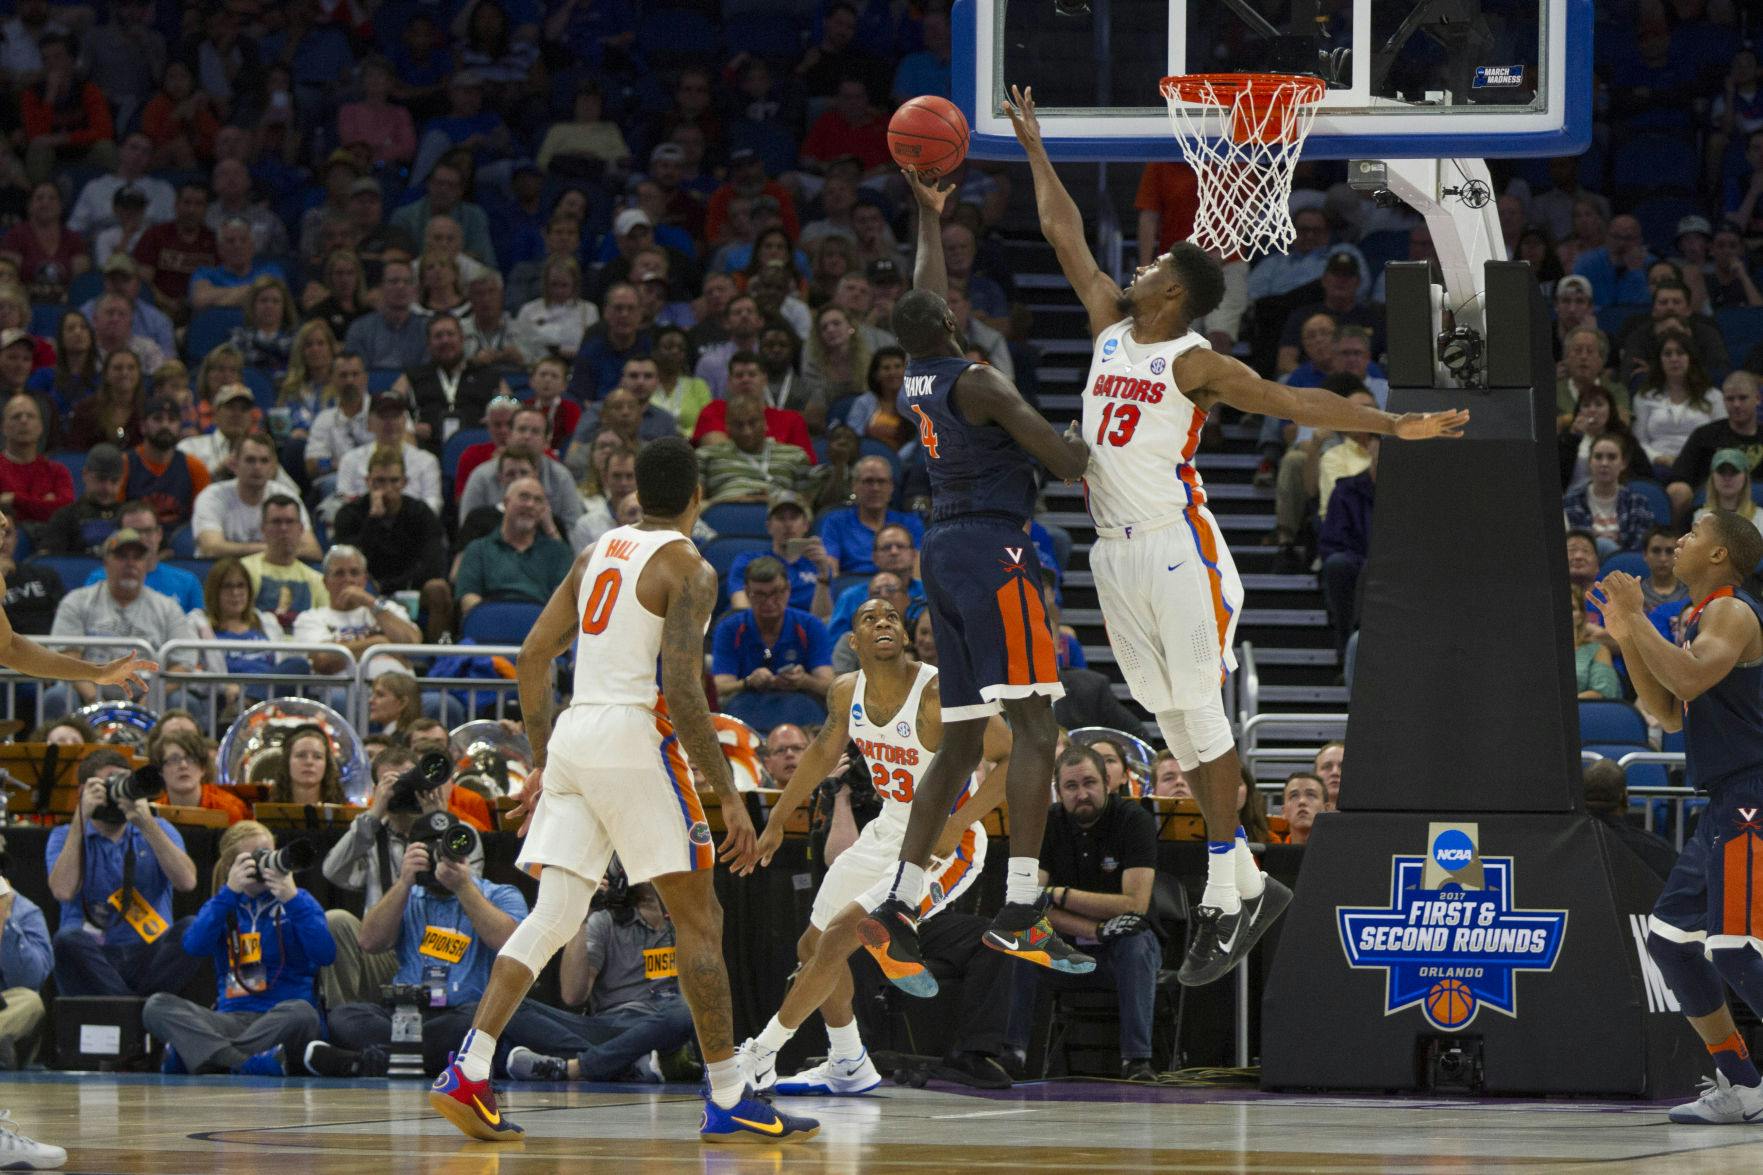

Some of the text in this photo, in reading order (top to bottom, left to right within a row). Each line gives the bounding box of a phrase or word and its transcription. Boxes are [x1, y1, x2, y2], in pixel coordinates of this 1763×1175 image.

[1484, 68, 1510, 76] MARCH
[1487, 75, 1522, 84] MADNESS
[1092, 374, 1166, 404] GATORS
[910, 404, 940, 459] 4
[1096, 401, 1141, 447] 13
[605, 538, 640, 561] HILL
[581, 567, 622, 635] 0
[871, 763, 915, 803] 23
[1436, 849, 1472, 861] NCAA
[1439, 892, 1466, 901] 2017
[1408, 901, 1496, 927] FIRST &
[1359, 926, 1547, 953] SECOND ROUNDS
[1419, 966, 1484, 978] ORLANDO
